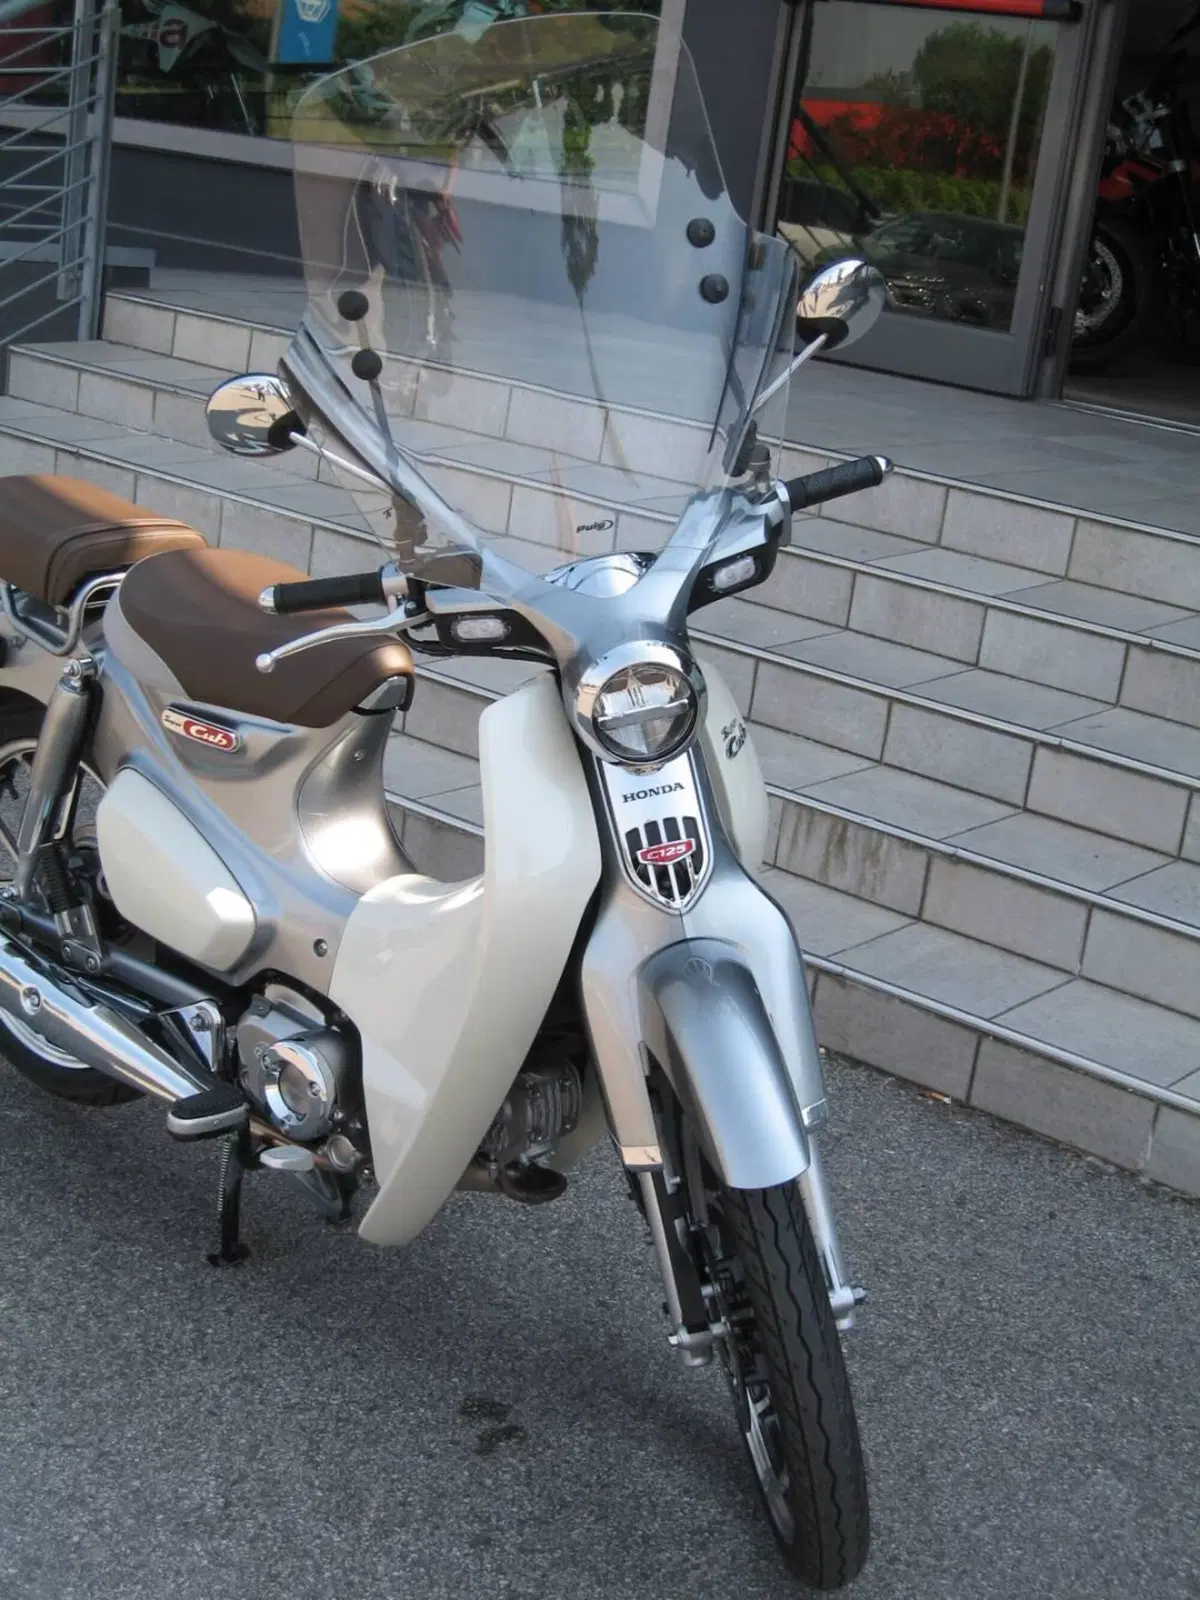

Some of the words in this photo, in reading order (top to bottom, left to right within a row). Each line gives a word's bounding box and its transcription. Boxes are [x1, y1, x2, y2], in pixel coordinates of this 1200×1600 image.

[189, 724, 228, 746] Cub
[622, 782, 686, 804] HONDA
[646, 843, 688, 860] C125
